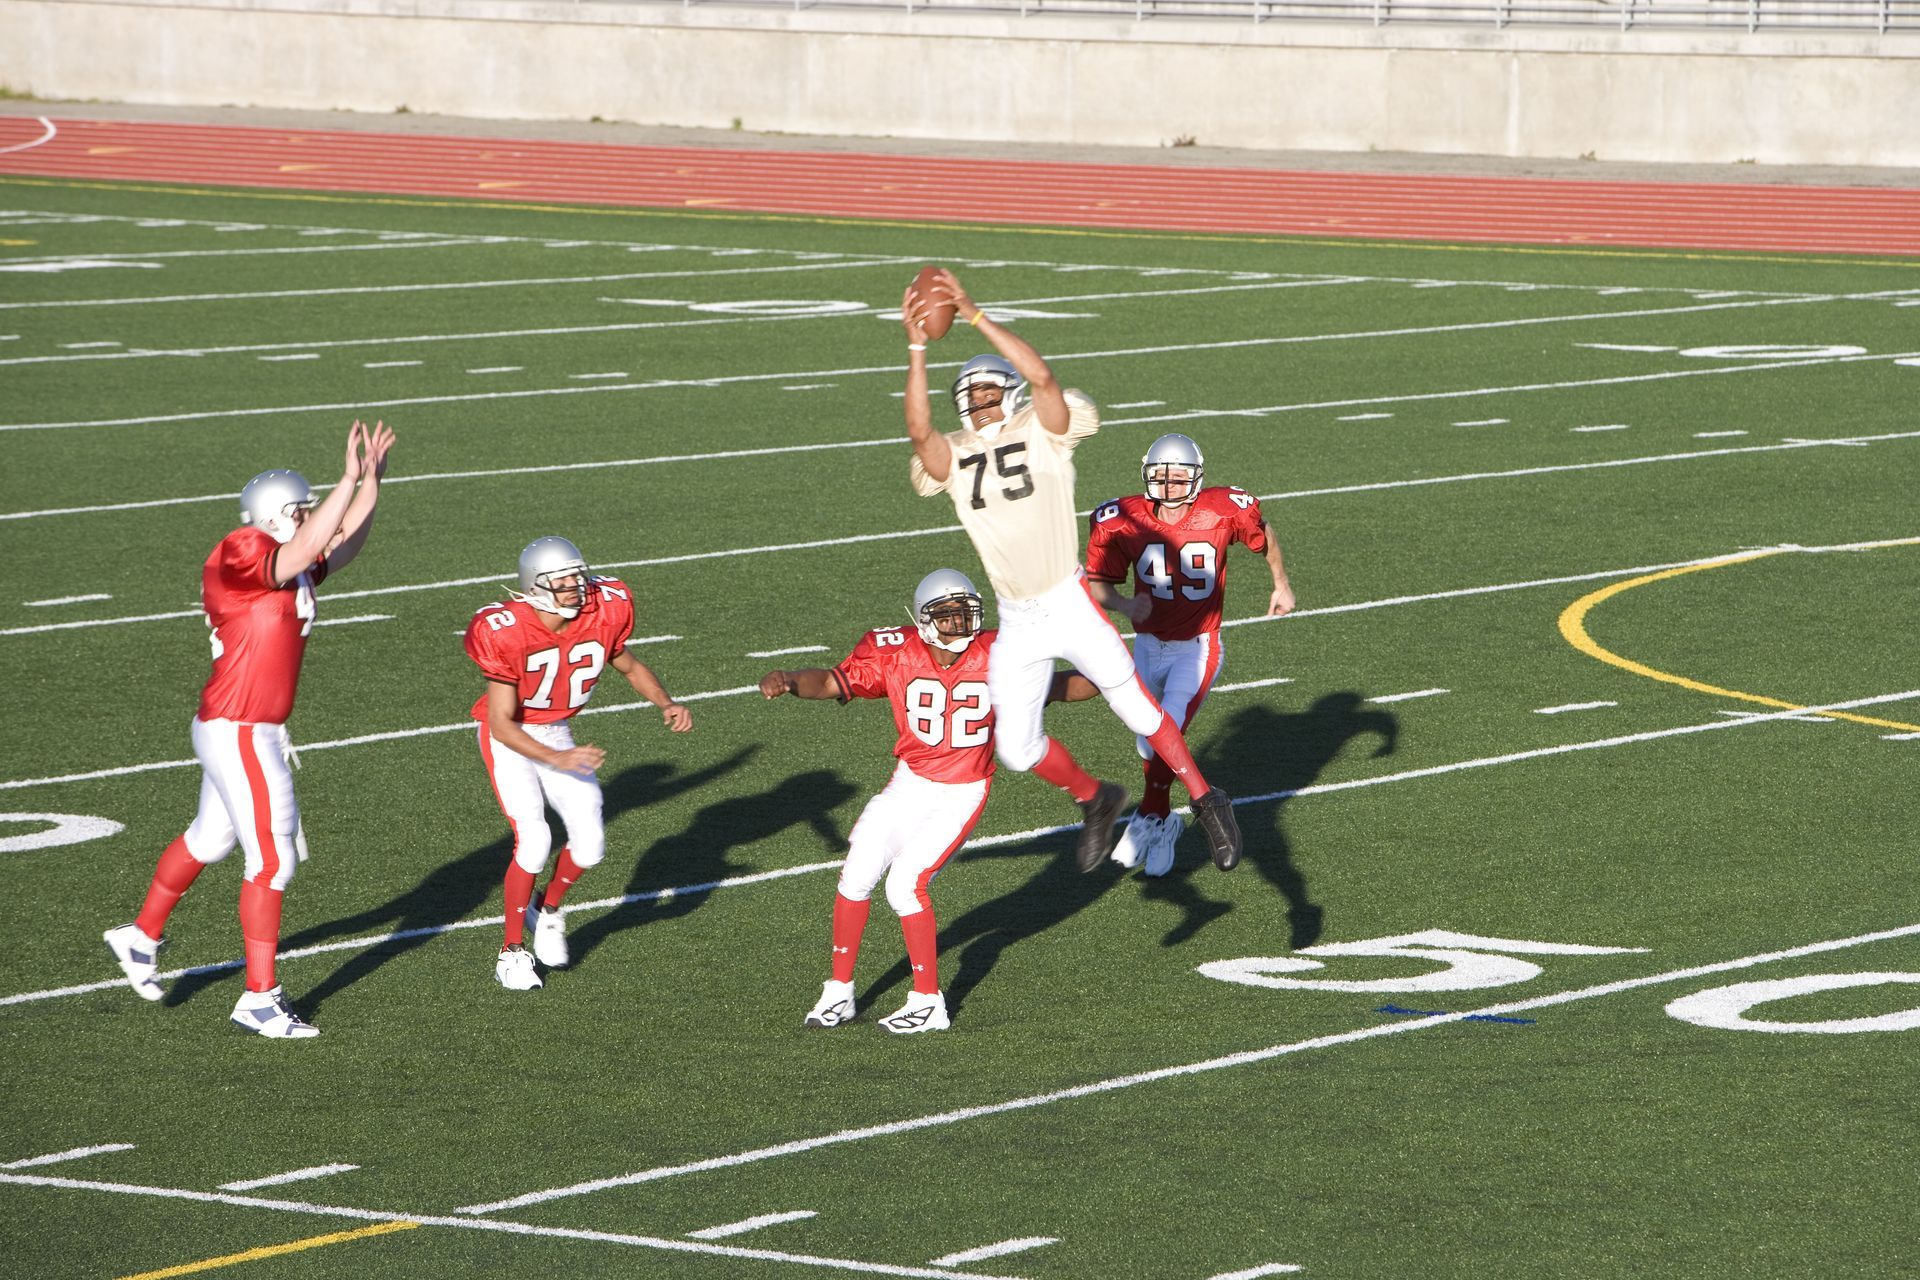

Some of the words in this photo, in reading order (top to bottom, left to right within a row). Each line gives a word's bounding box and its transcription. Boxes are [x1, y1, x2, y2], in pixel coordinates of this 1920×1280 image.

[959, 441, 1035, 510] 75
[1095, 497, 1120, 523] 9
[1136, 541, 1217, 601] 49
[522, 640, 606, 710] 72
[905, 676, 992, 749] 82
